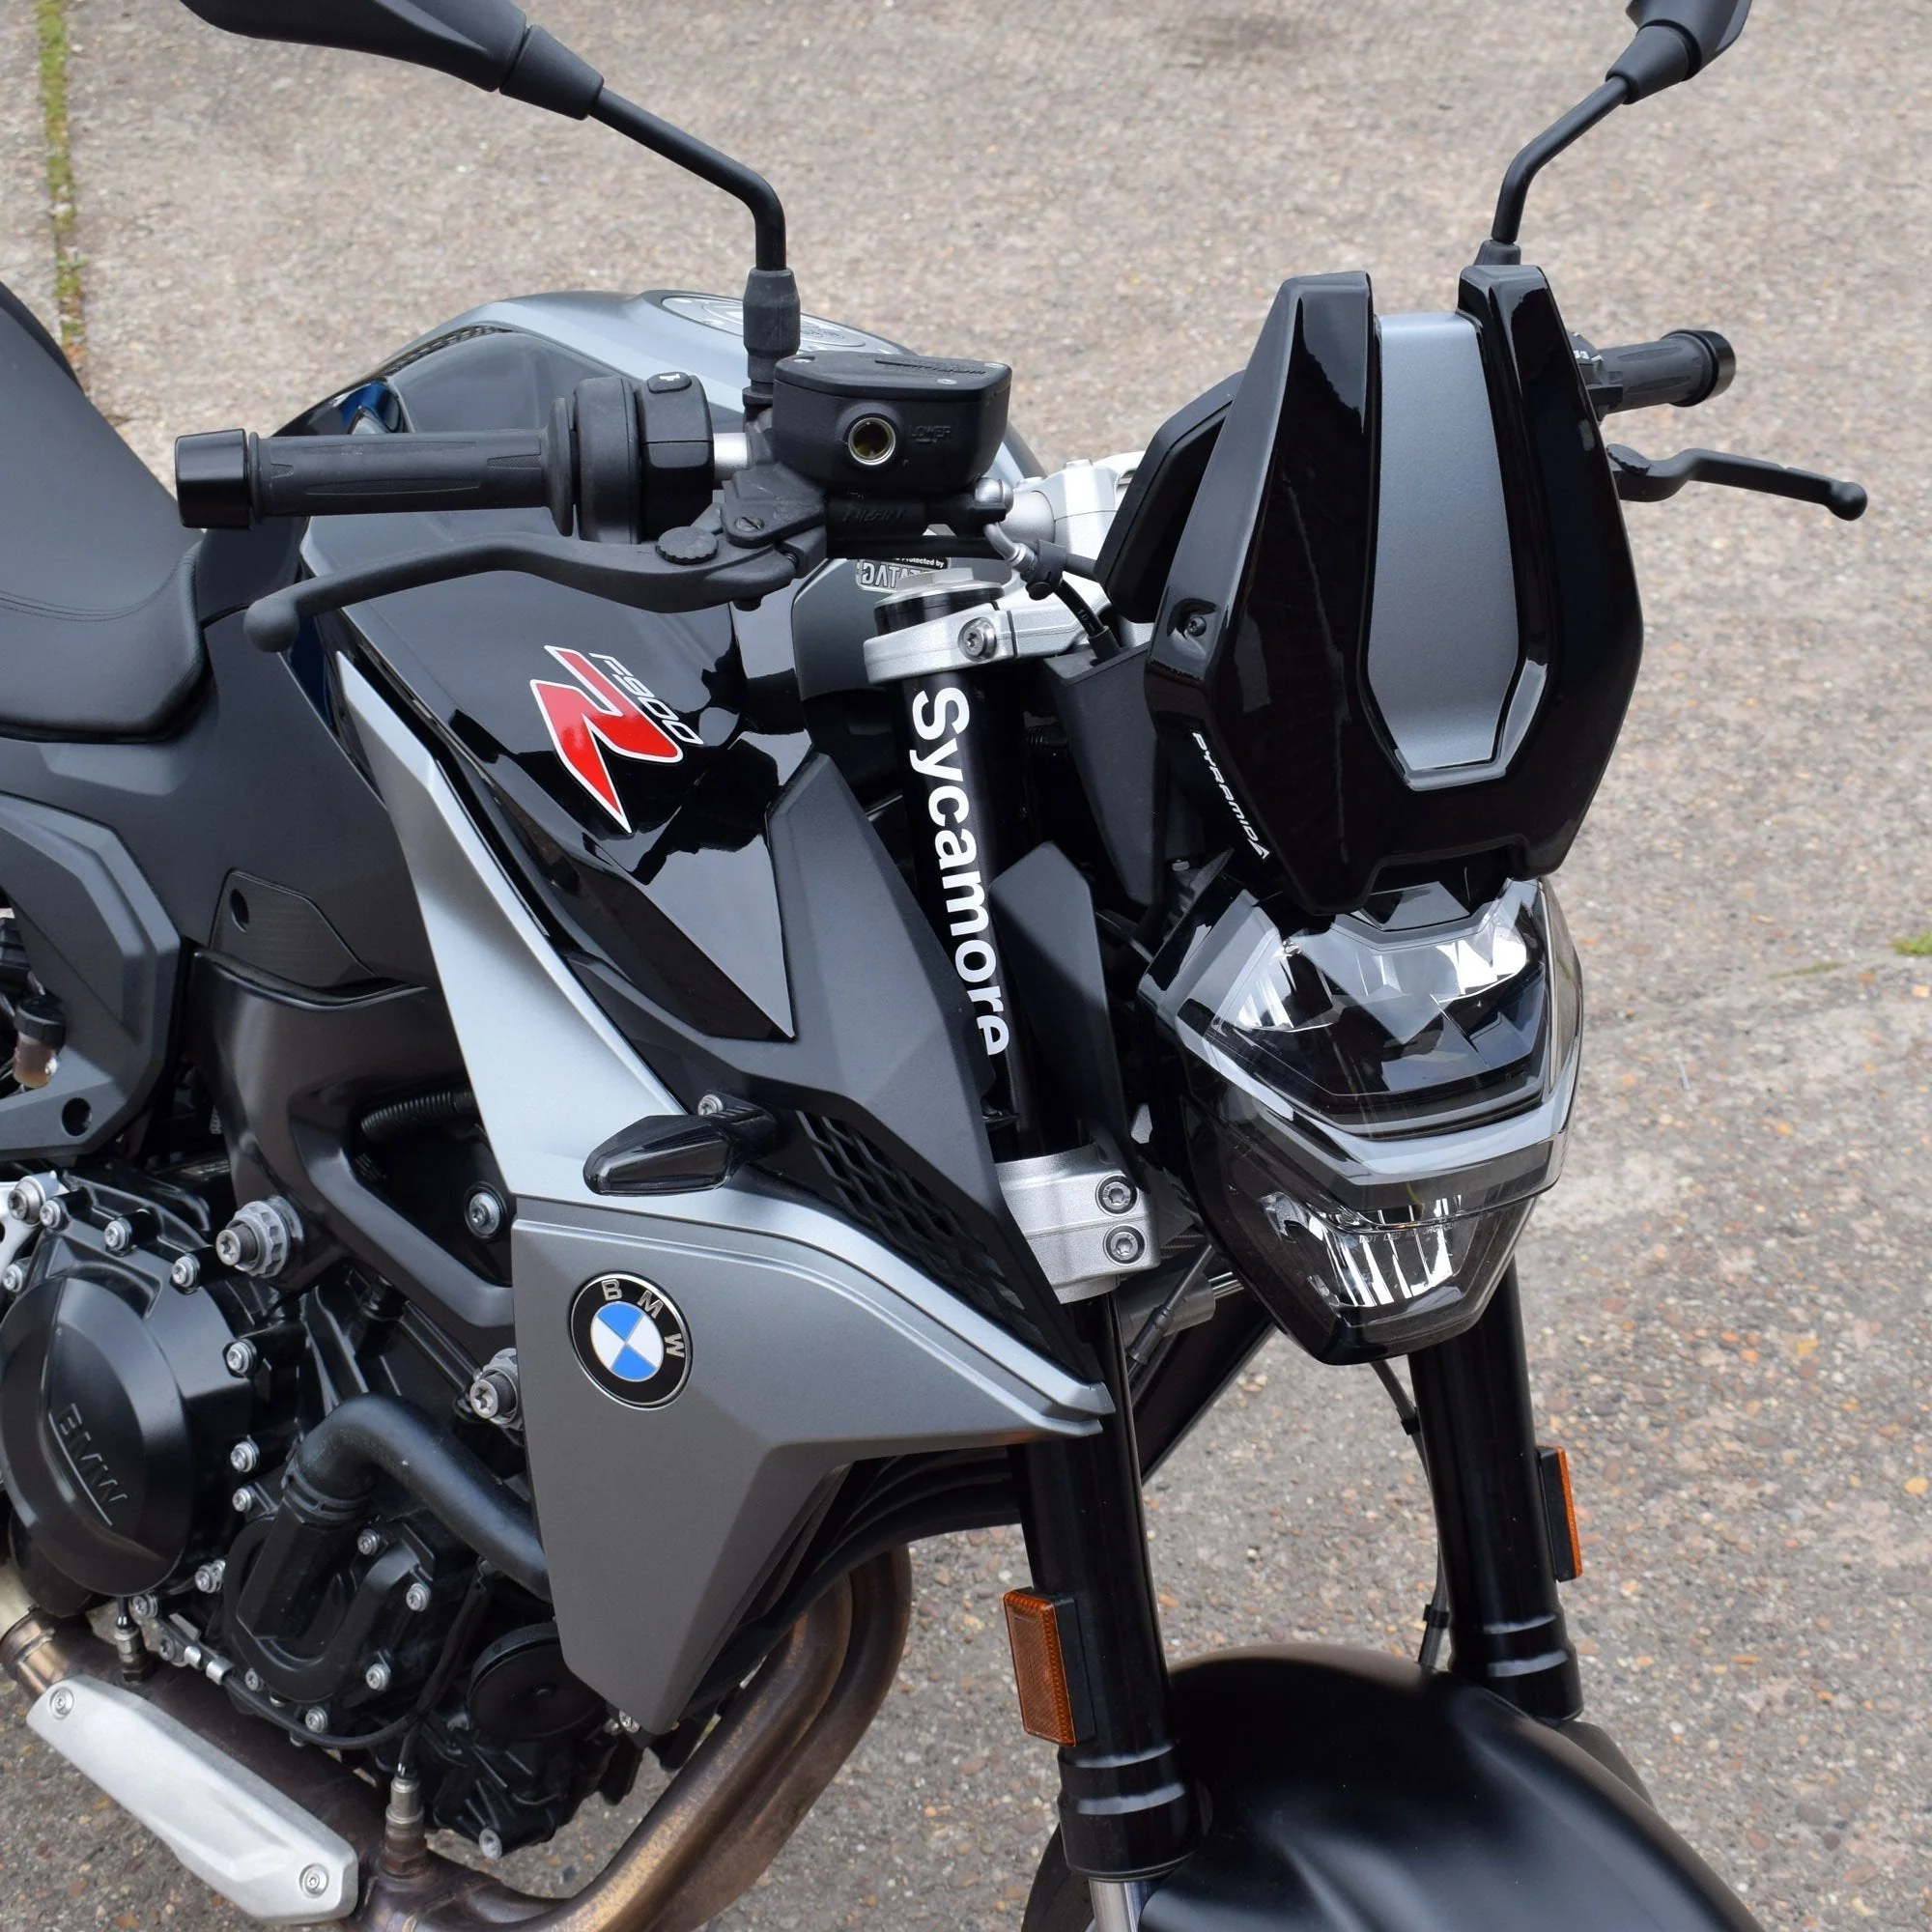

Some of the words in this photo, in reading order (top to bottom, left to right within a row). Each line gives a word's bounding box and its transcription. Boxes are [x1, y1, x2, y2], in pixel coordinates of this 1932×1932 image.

[588, 652, 704, 745] F900
[1192, 732, 1259, 841] PYRAMID
[909, 687, 1010, 1056] Sycamore
[601, 1278, 686, 1359] BMW
[55, 1403, 128, 1503] BMW
